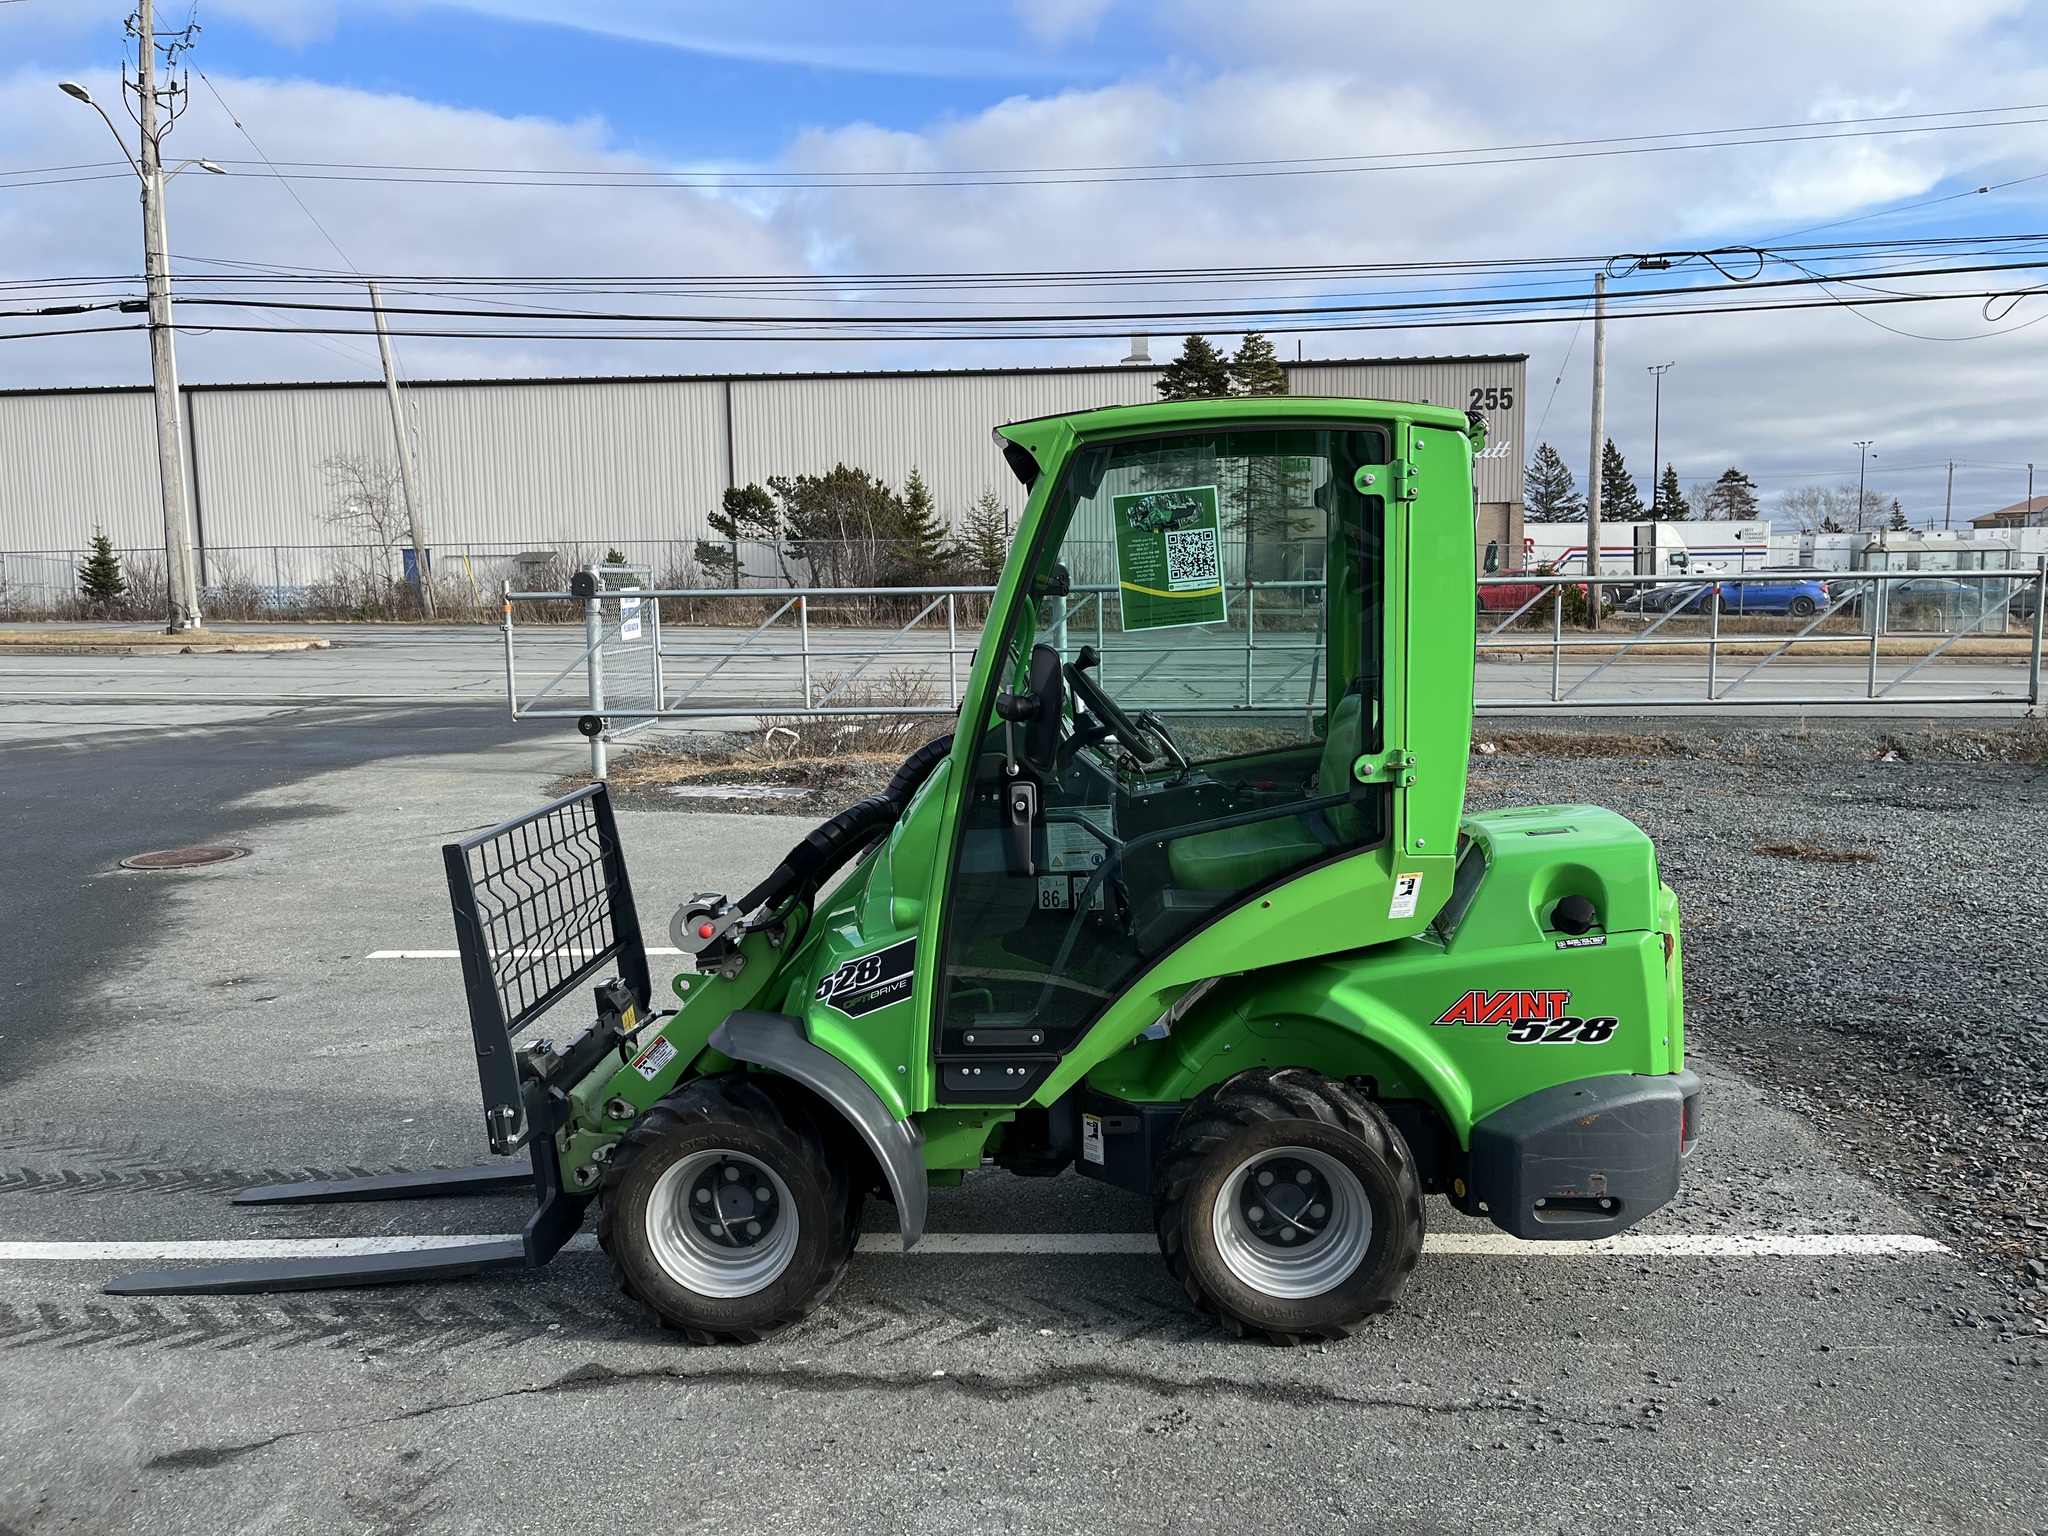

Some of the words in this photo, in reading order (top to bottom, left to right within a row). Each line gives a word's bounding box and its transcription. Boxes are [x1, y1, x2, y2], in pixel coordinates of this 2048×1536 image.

[1470, 388, 1513, 410] 255
[1042, 890, 1060, 907] 86
[815, 956, 882, 1001] 528
[843, 980, 907, 1009] OPTIDRIVE
[1431, 990, 1570, 1026] AVANT
[1506, 1016, 1620, 1044] 528
